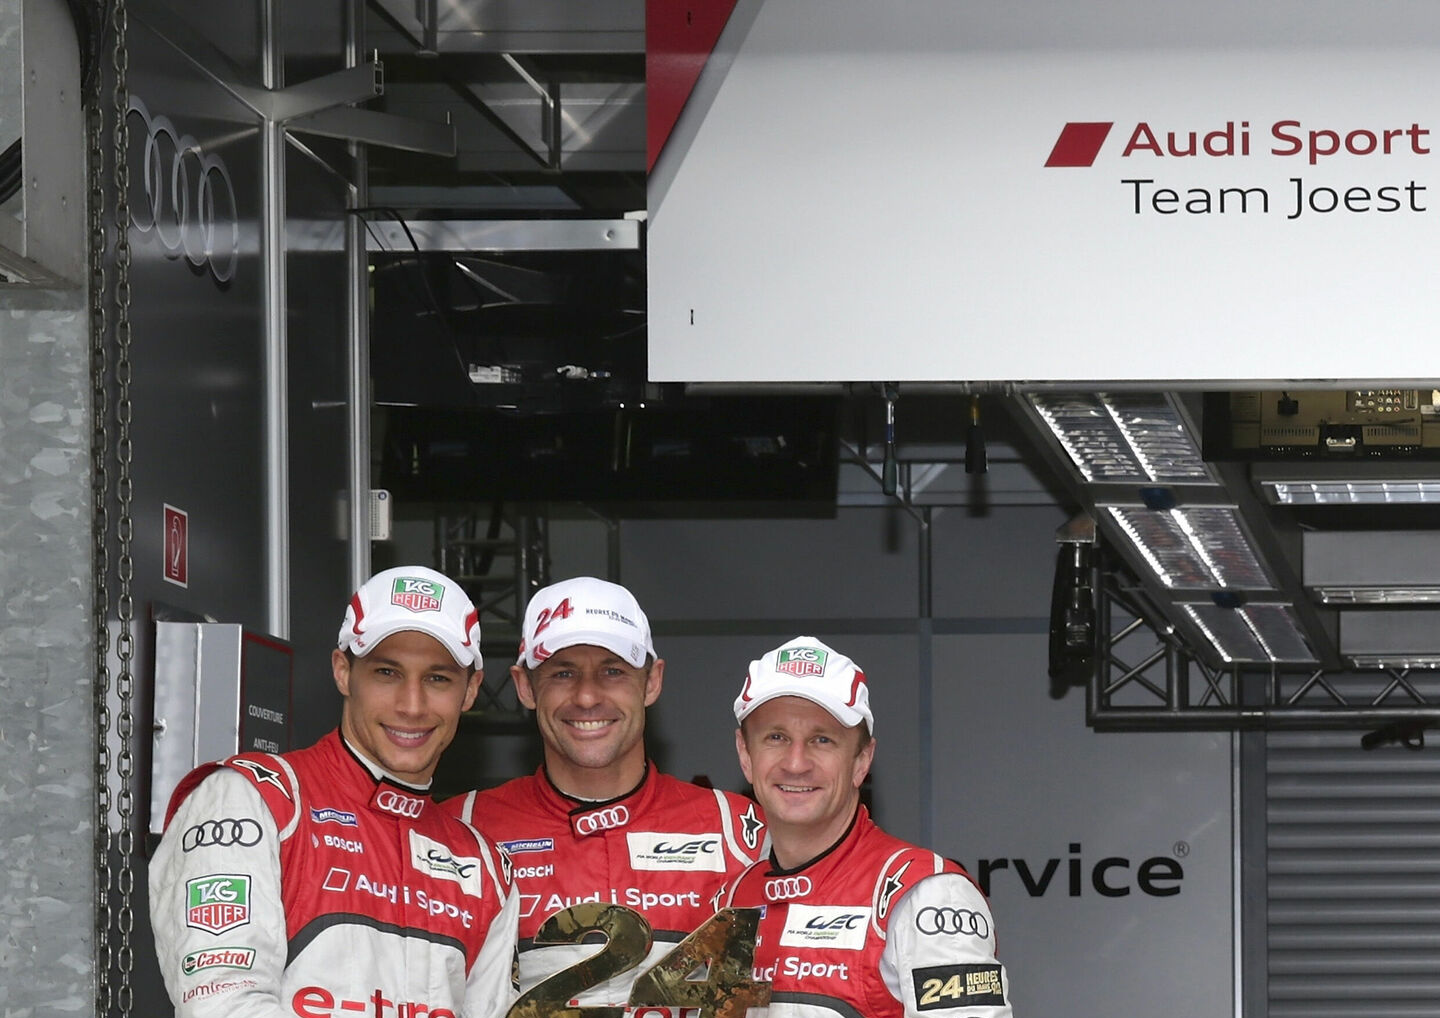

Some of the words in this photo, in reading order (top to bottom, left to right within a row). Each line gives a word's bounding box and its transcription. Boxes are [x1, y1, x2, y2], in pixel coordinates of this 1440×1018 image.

[1122, 119, 1251, 157] Audi
[1270, 119, 1431, 165] Sport
[1120, 178, 1270, 215] Team
[1286, 176, 1428, 220] Joest
[403, 579, 436, 595] TAG
[394, 593, 439, 610] HEUER
[533, 597, 574, 640] 24
[786, 649, 819, 661] TAG
[780, 660, 821, 675] HEUER
[324, 834, 364, 854] BOSCH
[978, 843, 1184, 897] rvice
[197, 880, 238, 903] TAG
[626, 888, 700, 910] Sport
[191, 905, 244, 927] HEUER
[415, 890, 473, 928] Spot
[197, 951, 251, 968] Castrol
[783, 957, 848, 980] Sport
[920, 974, 964, 1006] 24
[966, 970, 999, 985] HEURES
